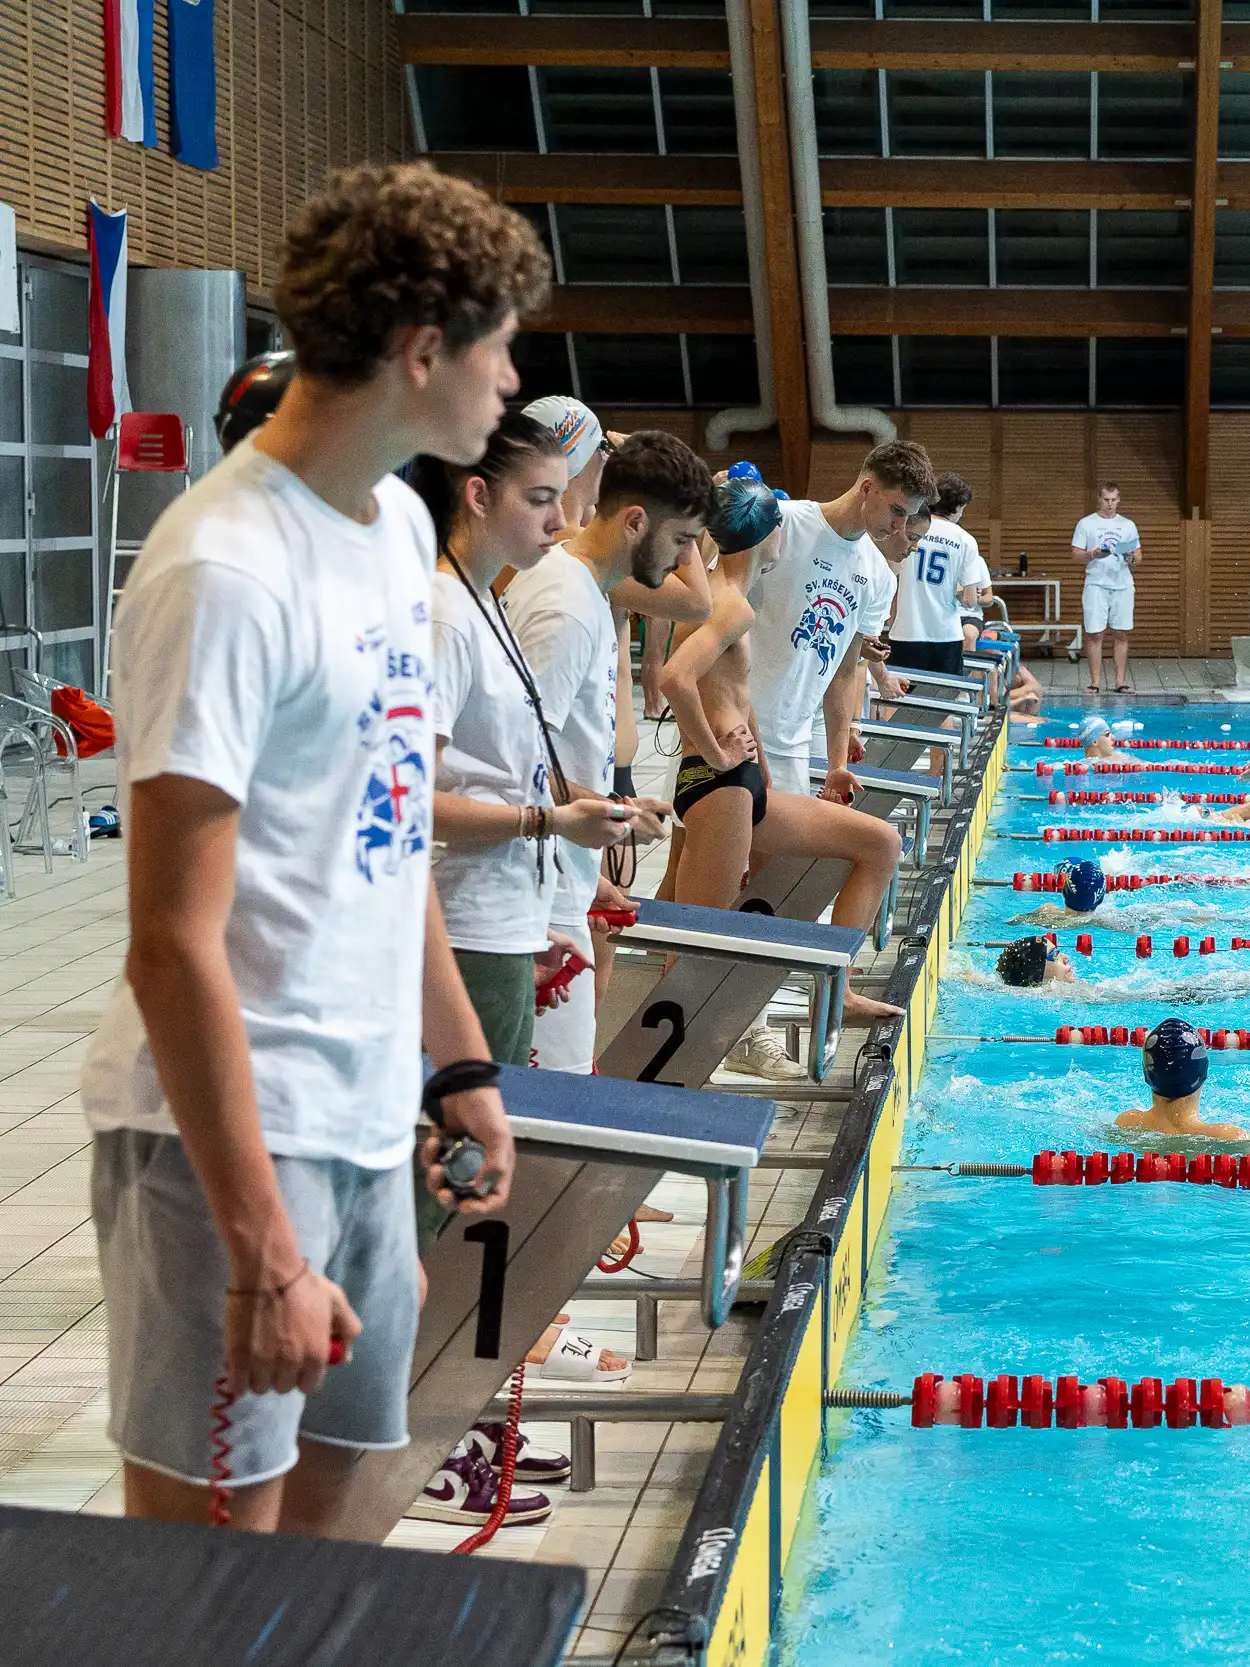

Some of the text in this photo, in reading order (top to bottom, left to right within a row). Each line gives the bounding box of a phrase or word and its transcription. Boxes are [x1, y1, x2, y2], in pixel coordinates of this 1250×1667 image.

[805, 578, 859, 612] SV. KRŠEVAN
[916, 546, 950, 585] 15
[636, 1000, 686, 1088] 2
[463, 1219, 510, 1360] 1
